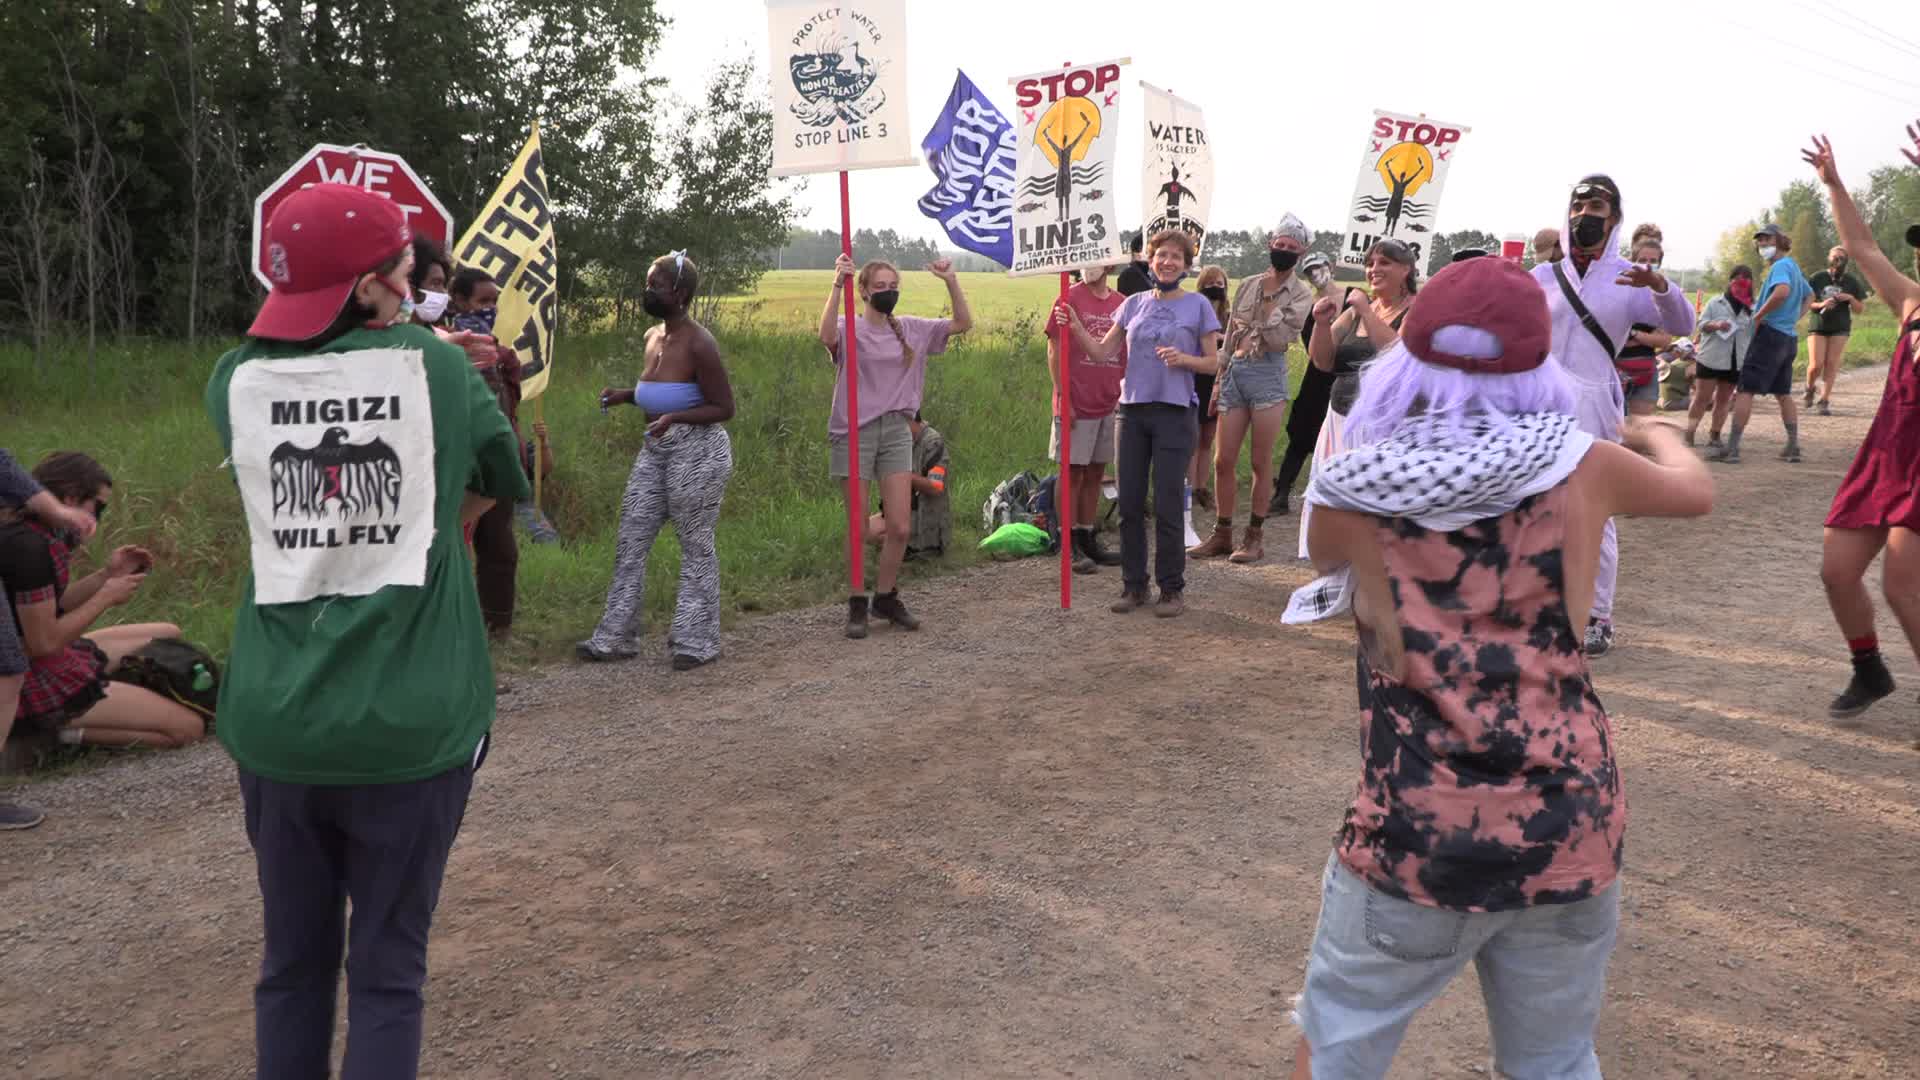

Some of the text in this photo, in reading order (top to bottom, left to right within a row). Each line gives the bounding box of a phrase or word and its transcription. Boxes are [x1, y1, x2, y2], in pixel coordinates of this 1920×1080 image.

[792, 8, 882, 46] PROTECT WATER
[800, 76, 836, 92] HONOR
[827, 77, 870, 96] TREATIES
[1016, 63, 1120, 108] STOP
[795, 122, 888, 148] STOP LINE 3
[1149, 119, 1206, 145] WATER
[1373, 117, 1461, 147] STOP
[1156, 143, 1163, 152] IS
[316, 156, 394, 200] WE
[1019, 213, 1106, 254] LINE 3
[1015, 247, 1112, 272] CLIMATE CRISIS
[1027, 242, 1099, 259] TAR SANDS PIPELINE
[271, 395, 401, 425] MIGIZI
[272, 524, 402, 550] WILL FLY
